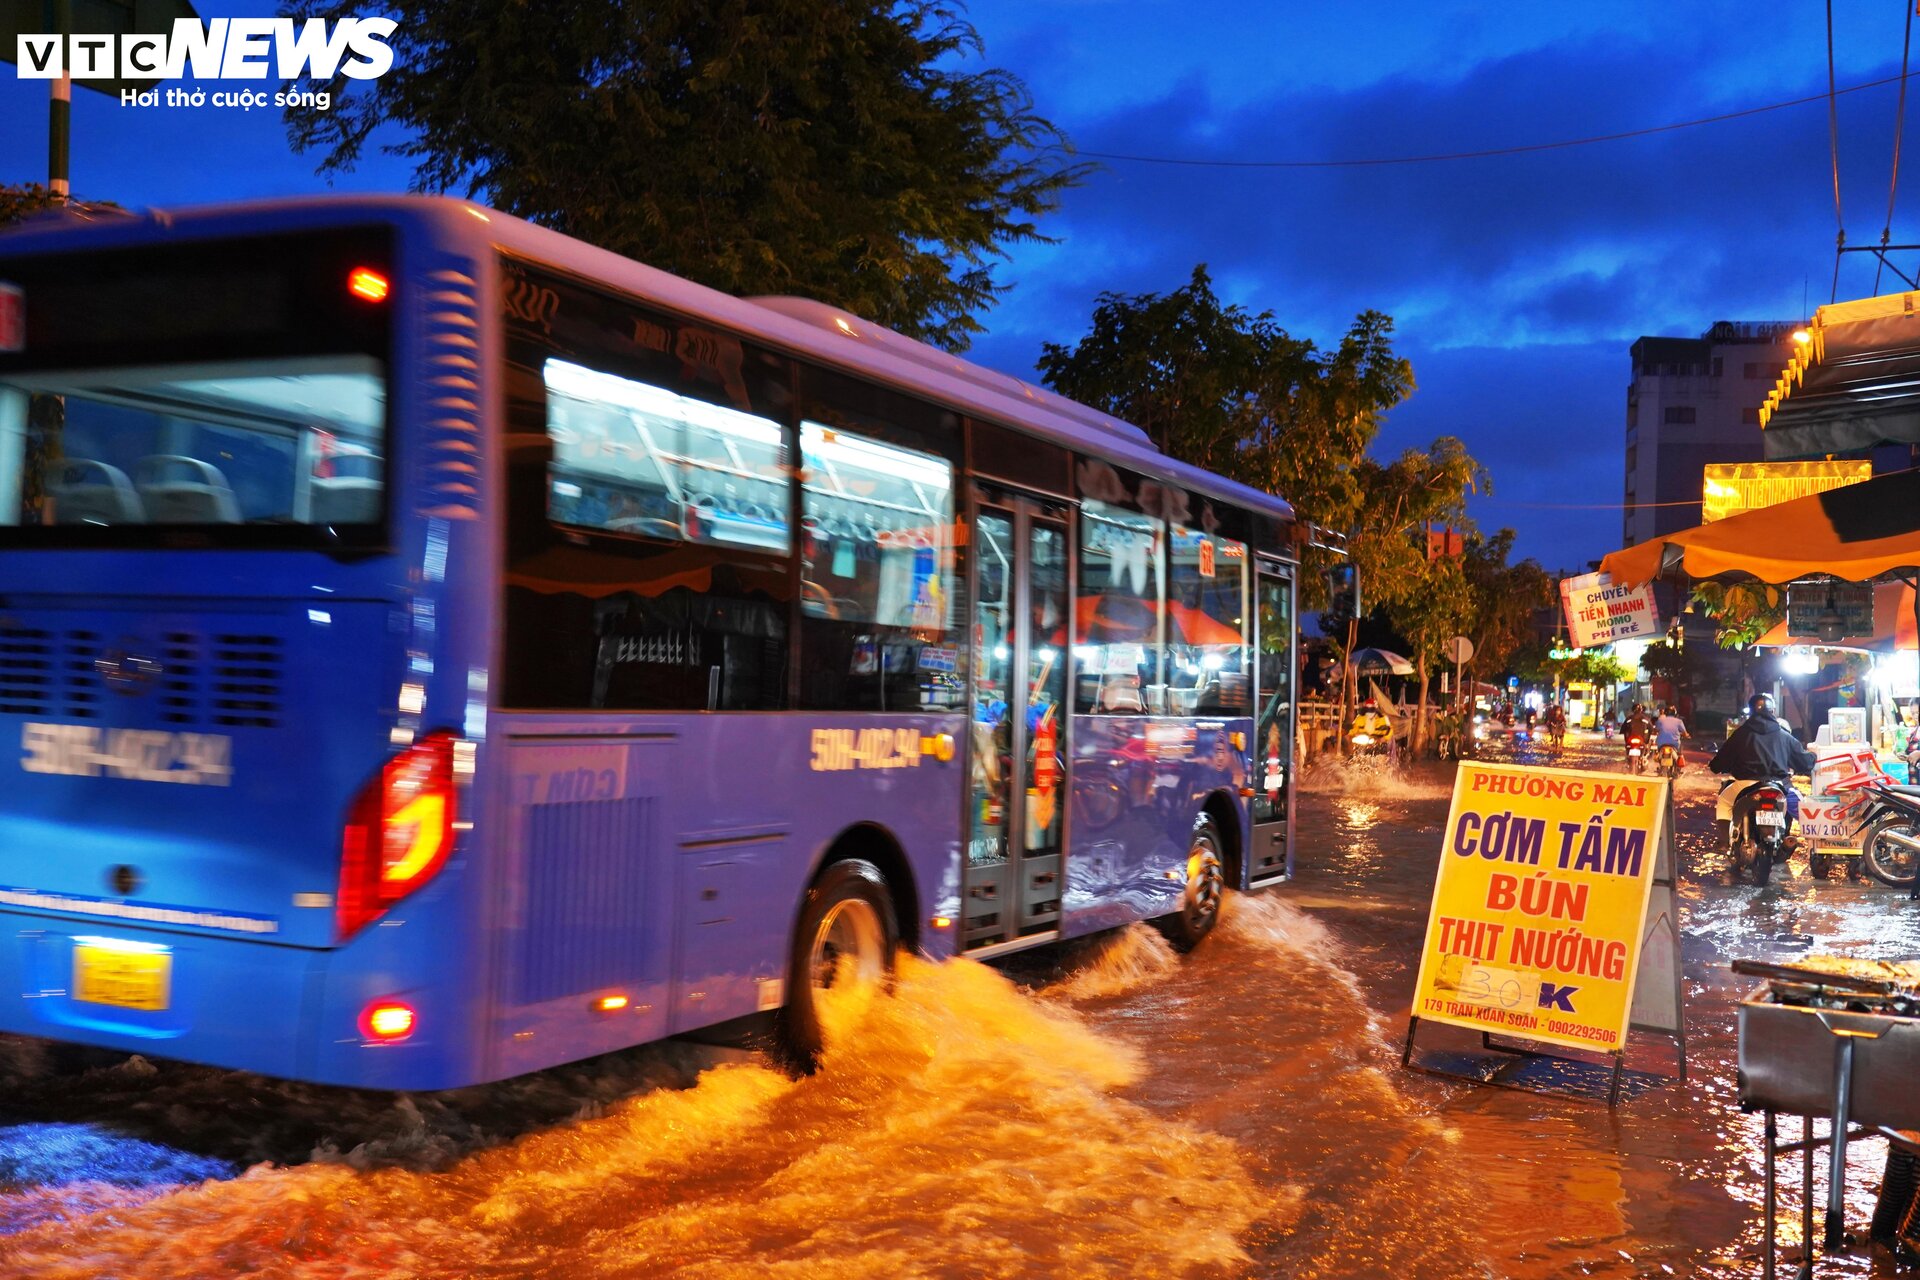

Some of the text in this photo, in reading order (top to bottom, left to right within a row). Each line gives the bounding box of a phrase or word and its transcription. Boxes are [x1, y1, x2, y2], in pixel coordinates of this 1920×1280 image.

[1597, 614, 1632, 628] MOMO
[1607, 598, 1645, 616] NHANH
[1592, 627, 1616, 640] PHÍ
[1472, 773, 1648, 807] PHƯƠNG MAI
[1454, 809, 1647, 877] CƠM TẤM
[1486, 872, 1589, 921] BÚN
[1439, 917, 1627, 981] THỊT NƯỚNG
[1538, 982, 1580, 1013] K
[1424, 998, 1442, 1012] 179
[1548, 1021, 1617, 1043] 0902292506
